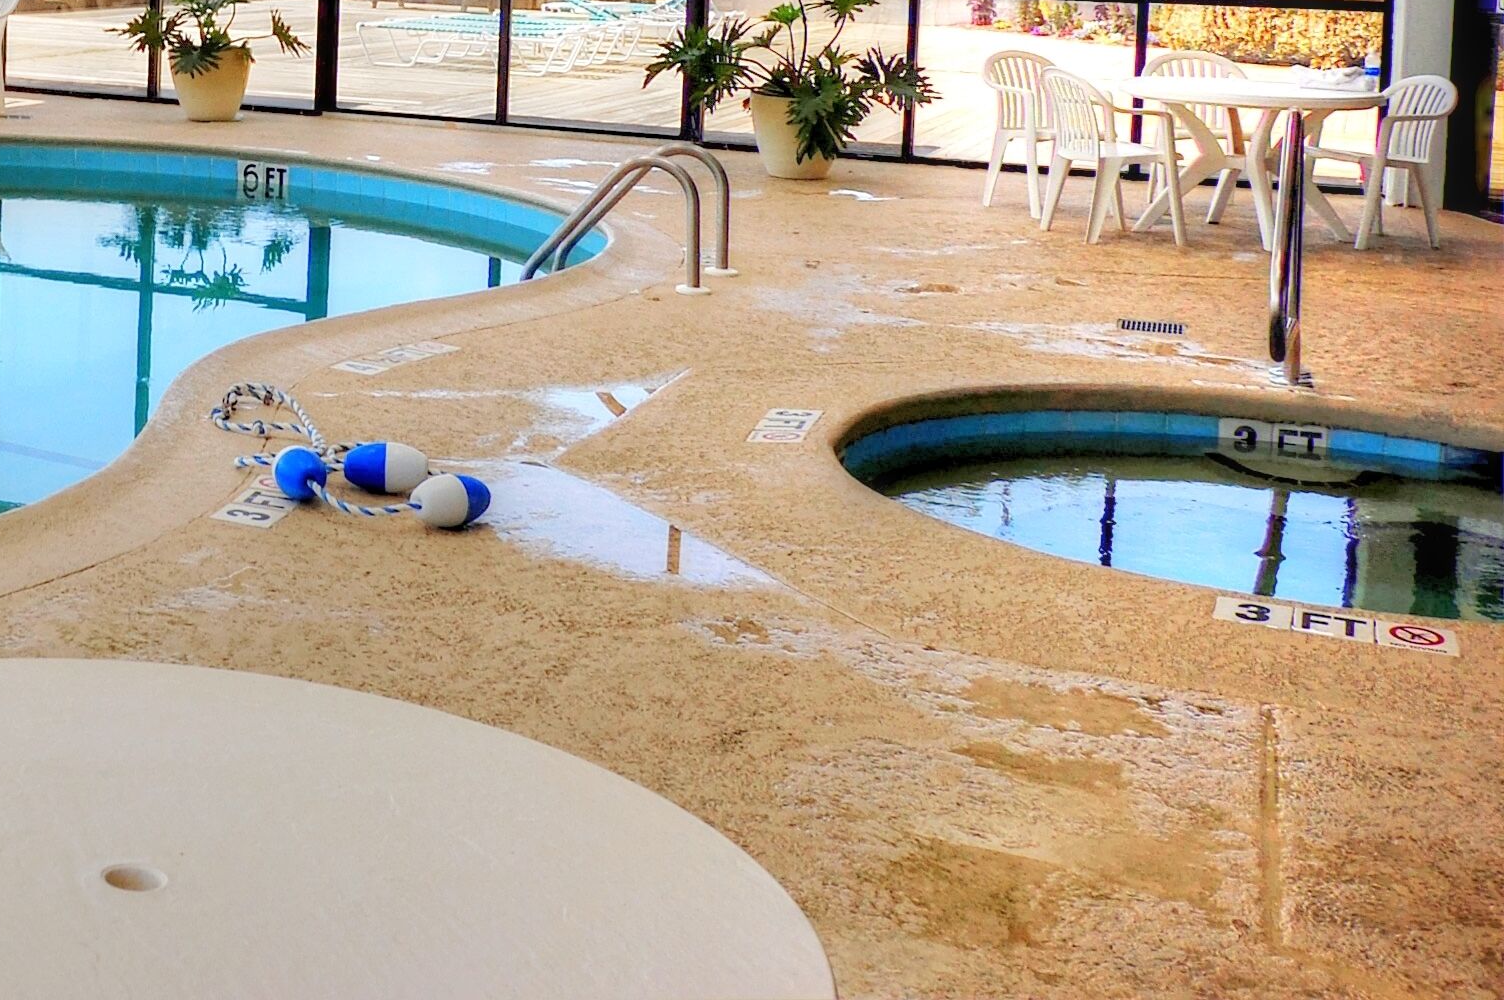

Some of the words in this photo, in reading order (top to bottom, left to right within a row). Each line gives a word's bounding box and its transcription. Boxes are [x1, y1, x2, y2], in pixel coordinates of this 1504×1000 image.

[243, 490, 294, 509] FT
[226, 509, 271, 521] 3
[1235, 603, 1271, 621] 3
[1302, 612, 1367, 637] FT
